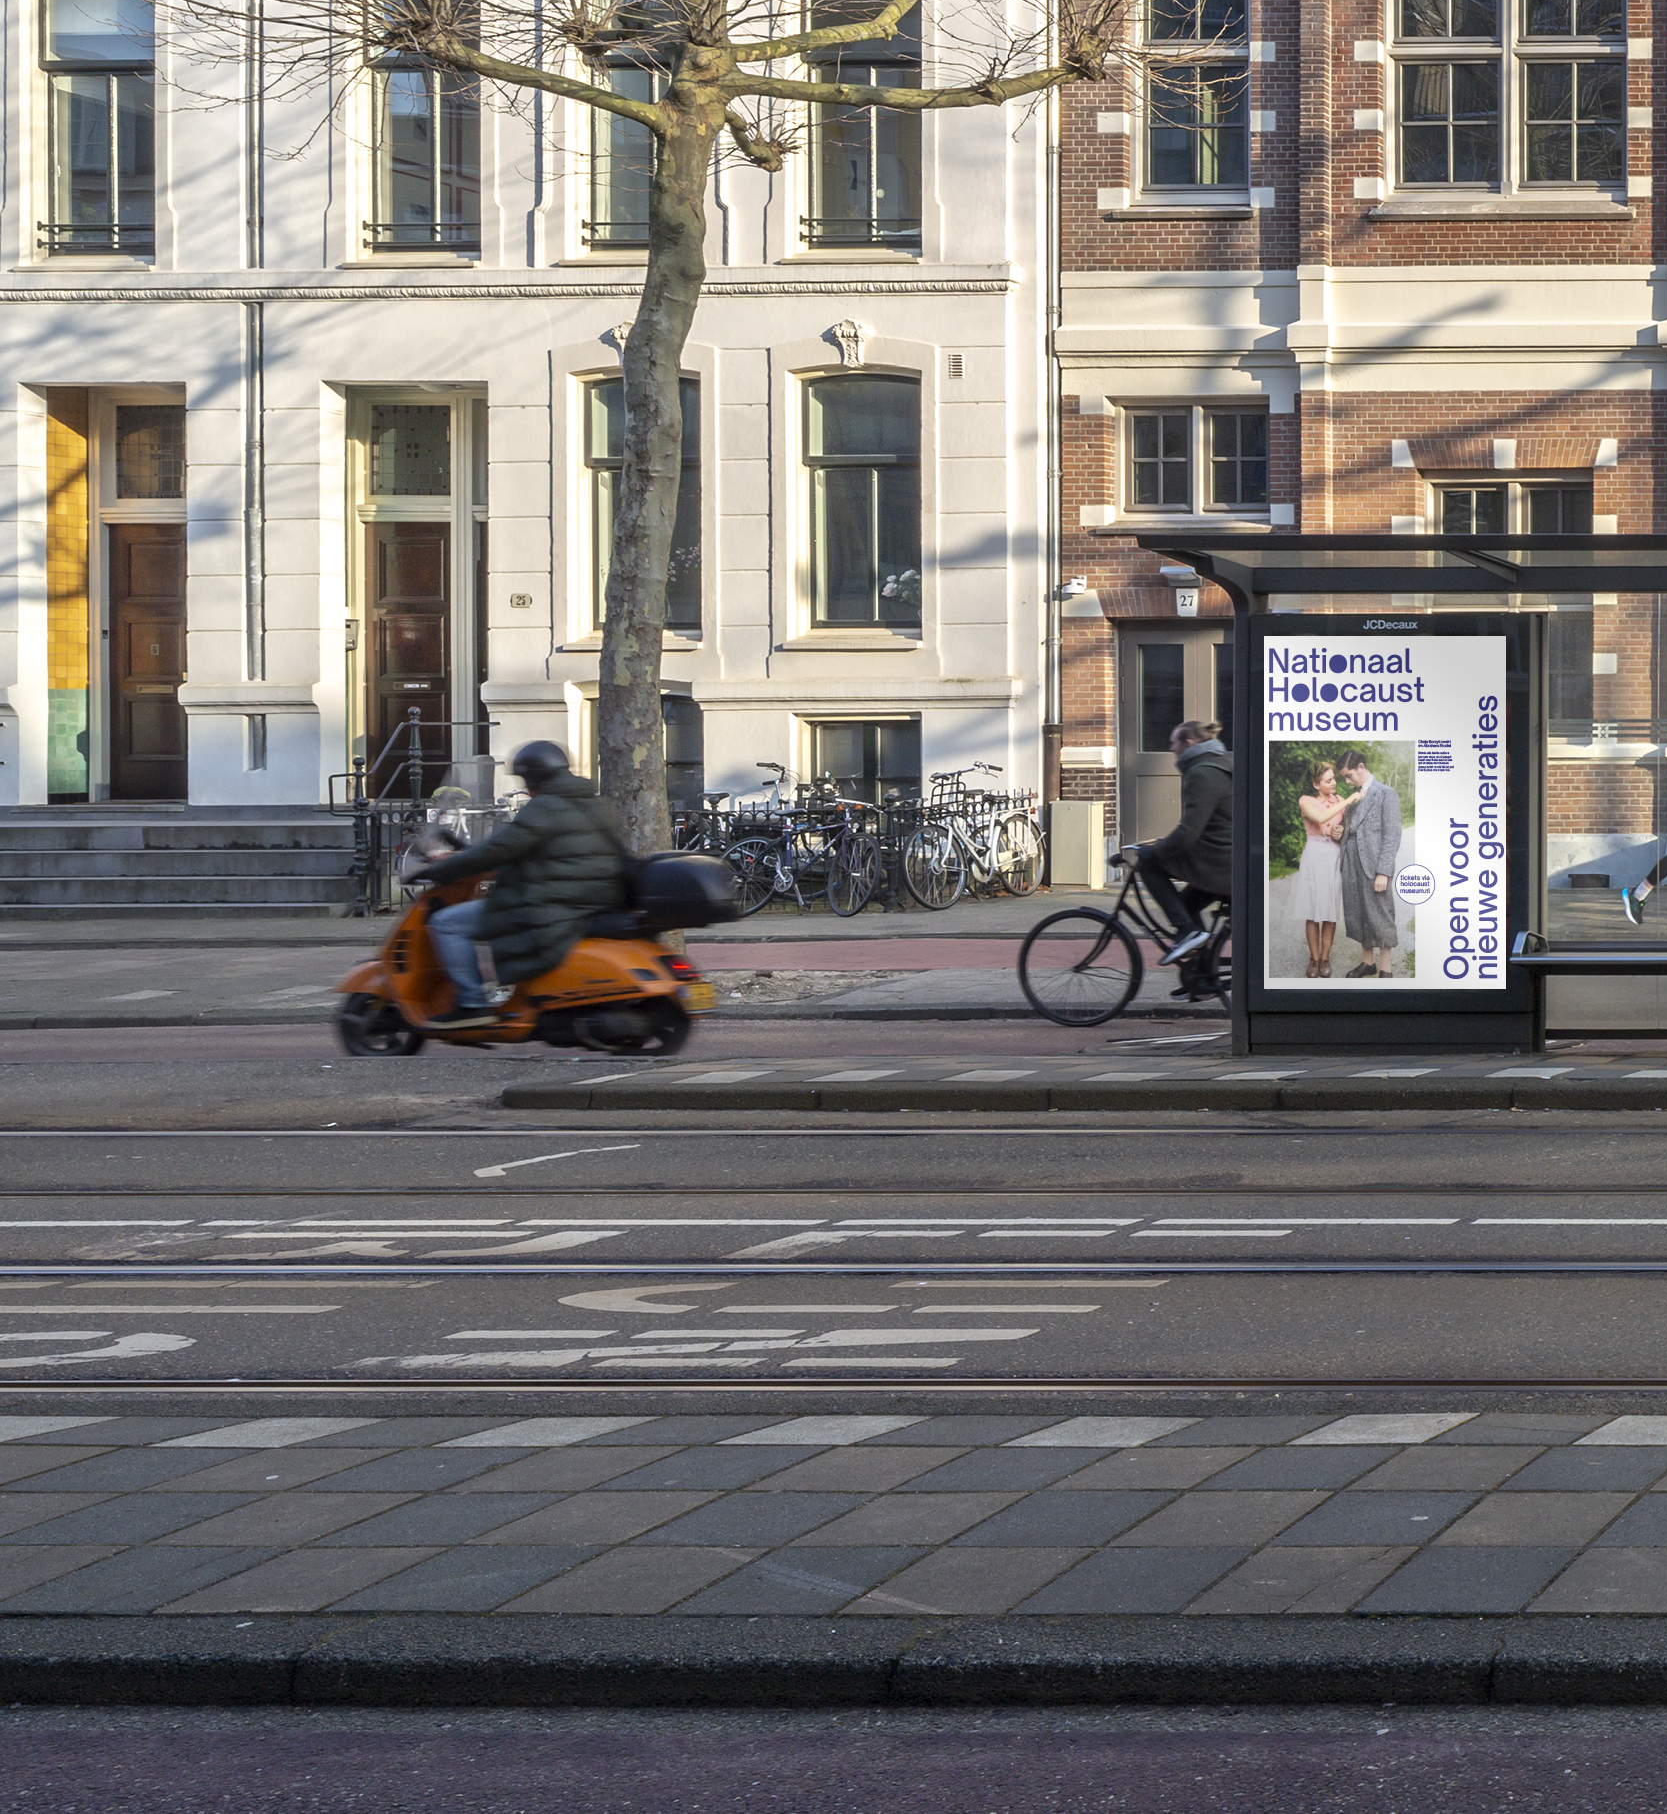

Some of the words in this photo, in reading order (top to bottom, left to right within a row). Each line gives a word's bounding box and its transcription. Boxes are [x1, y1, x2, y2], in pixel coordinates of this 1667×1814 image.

[516, 595, 526, 606] 25
[1179, 594, 1194, 607] 27
[1362, 619, 1418, 630] JCDecaux
[1268, 647, 1413, 674] Nationaal
[1268, 676, 1425, 703] Holocaust
[1268, 711, 1399, 732] museum
[1472, 695, 1504, 860] generaties
[1448, 817, 1470, 886] voor
[1472, 869, 1499, 979] nieuwe
[1442, 896, 1475, 980] Open
